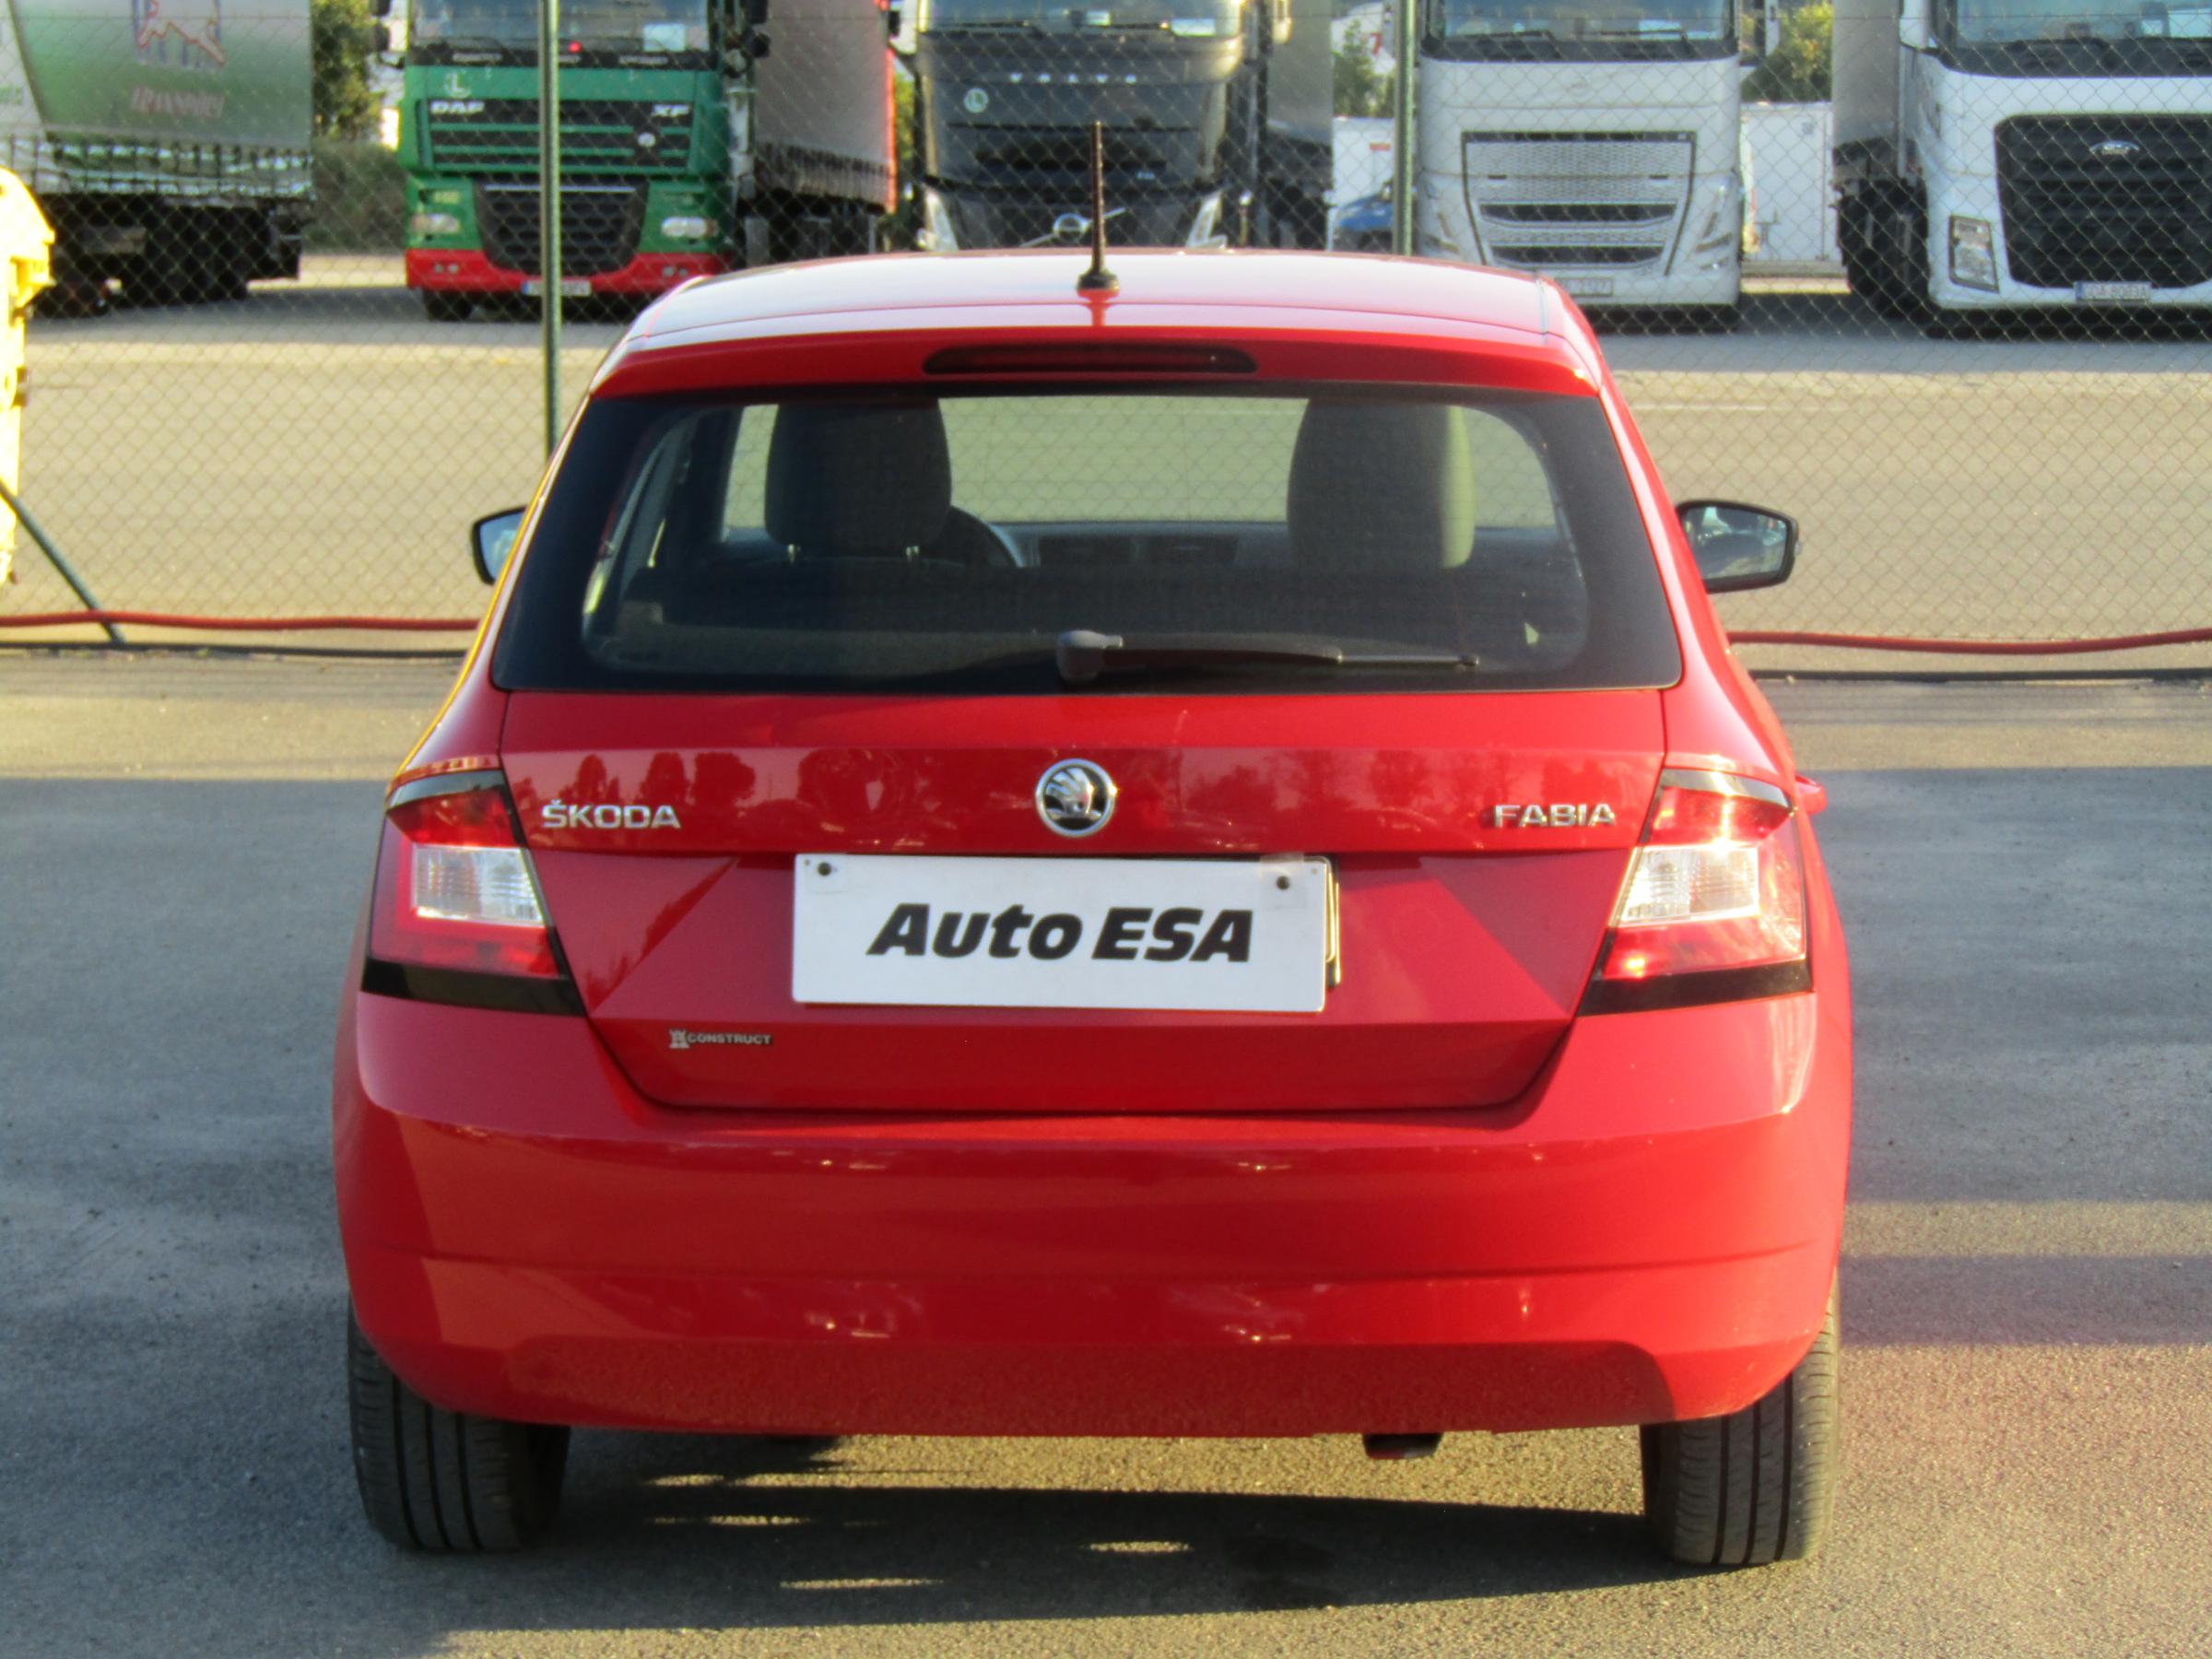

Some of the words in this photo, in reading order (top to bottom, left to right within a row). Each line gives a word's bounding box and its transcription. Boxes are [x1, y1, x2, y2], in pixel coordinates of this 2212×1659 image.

[430, 101, 485, 114] DAF
[541, 799, 681, 829] ŠKODA
[1494, 804, 1616, 828] FABIA
[865, 902, 1083, 960] Auto
[1091, 907, 1253, 962] ESA
[688, 1033, 771, 1045] CONSTRUCT
